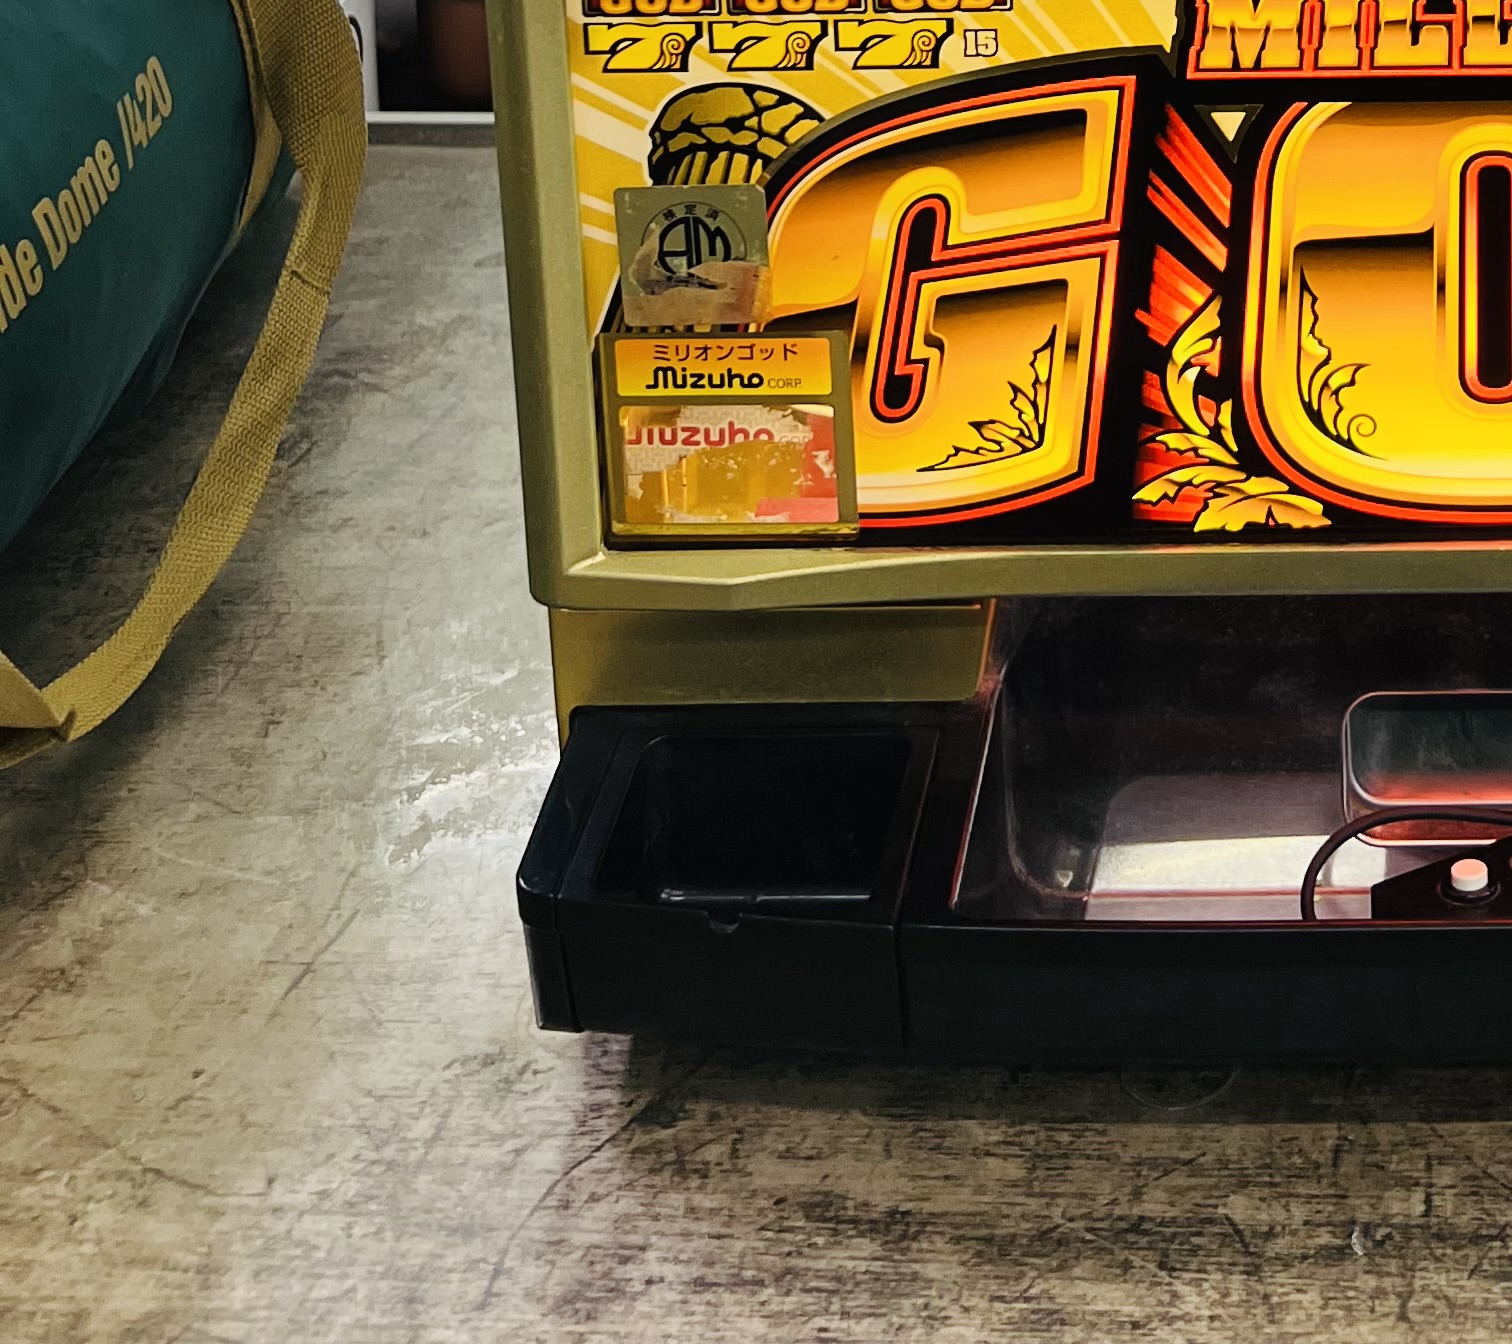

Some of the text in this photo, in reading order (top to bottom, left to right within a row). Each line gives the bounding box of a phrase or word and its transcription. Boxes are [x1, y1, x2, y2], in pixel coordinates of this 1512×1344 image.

[584, 18, 998, 73] 7 7 7 15
[32, 139, 120, 270] Dome
[653, 342, 799, 362] ミリオンゴッド
[645, 366, 764, 390] Mizuho
